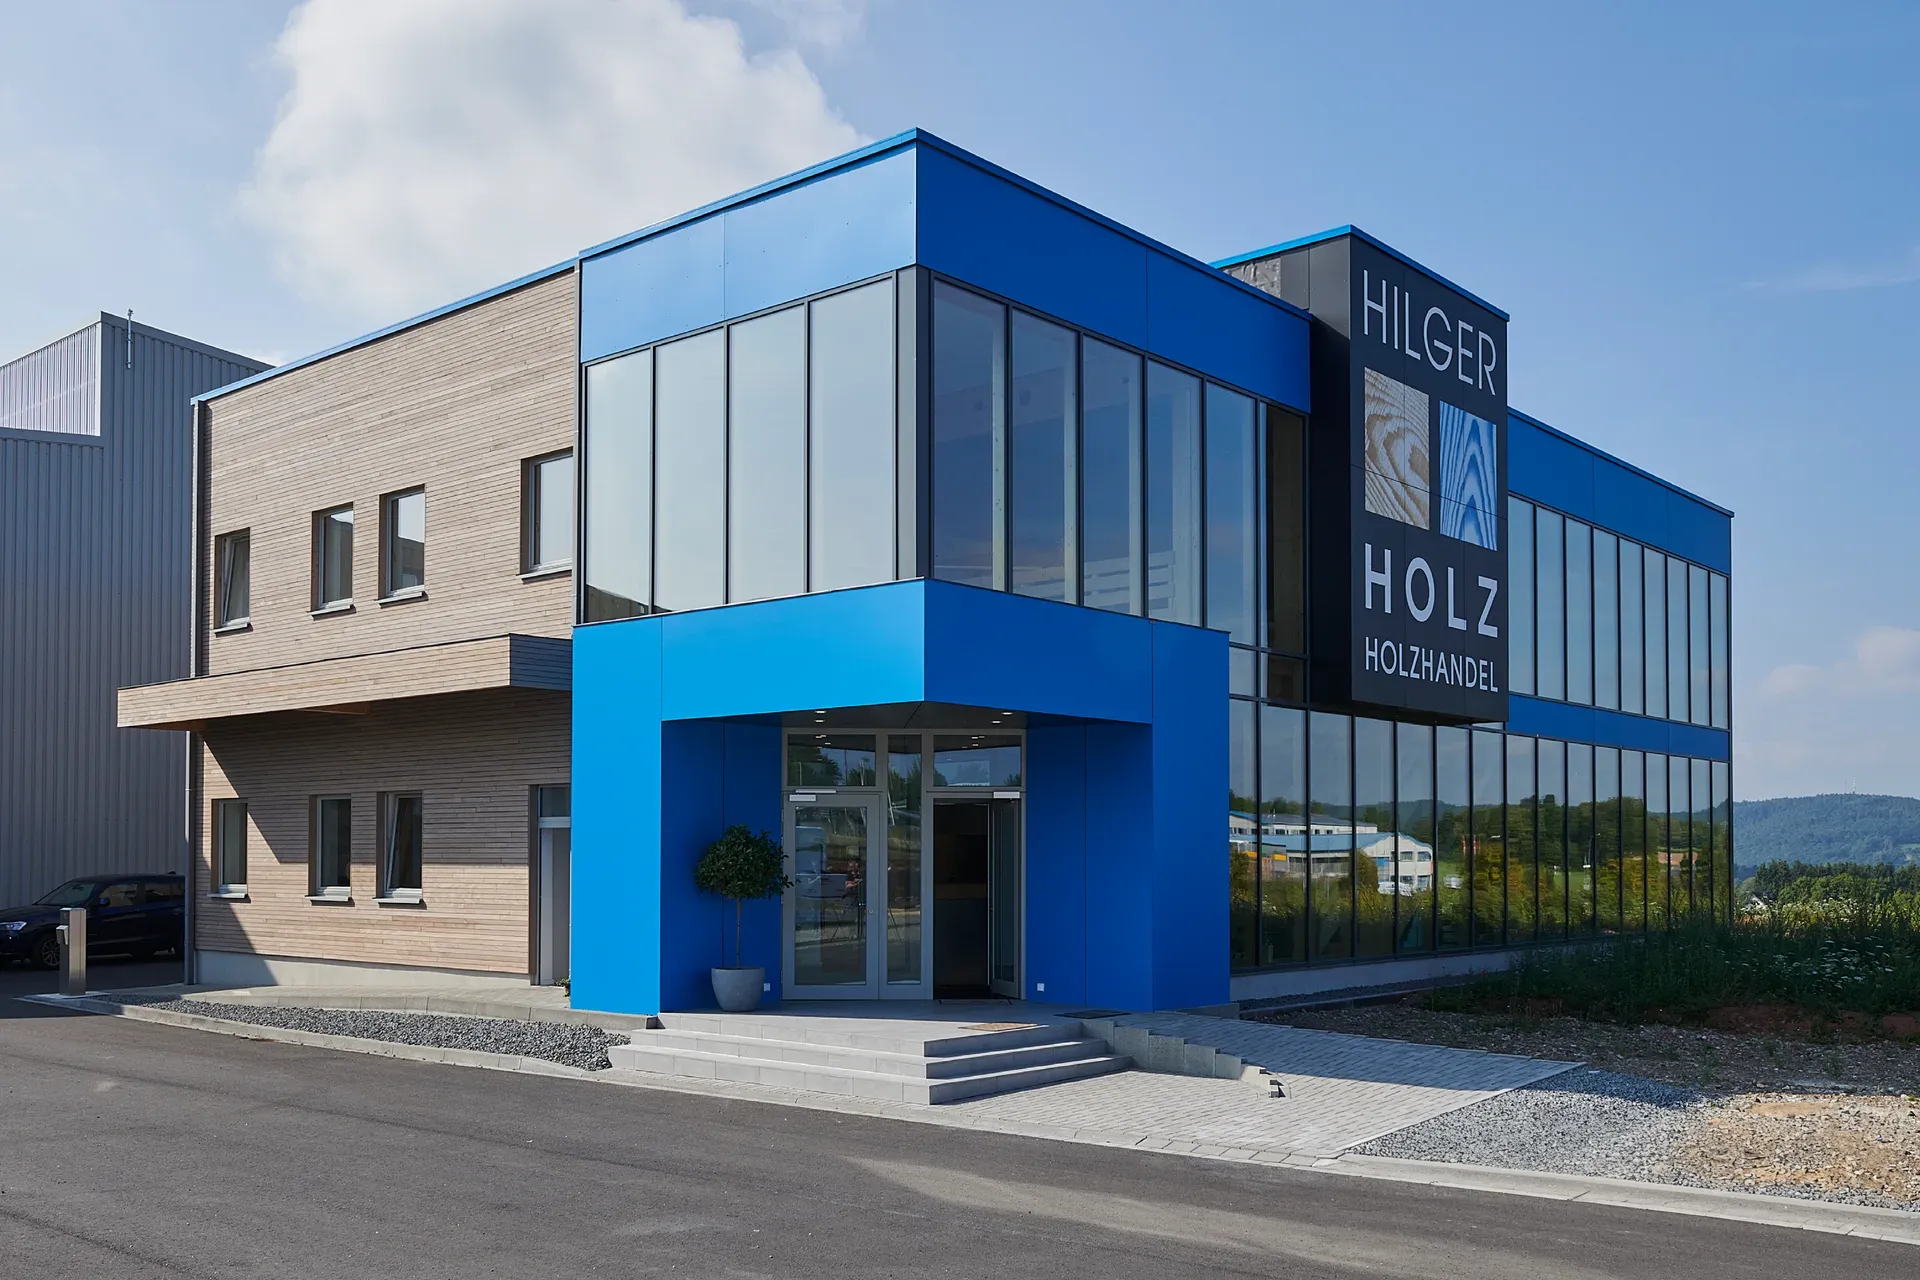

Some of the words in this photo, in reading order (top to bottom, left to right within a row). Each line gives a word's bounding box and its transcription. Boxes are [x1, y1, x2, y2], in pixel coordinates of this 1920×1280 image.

[1363, 269, 1496, 396] HILGER
[1364, 542, 1499, 638] HOLZ
[1364, 636, 1499, 693] HOLZHANDEL
